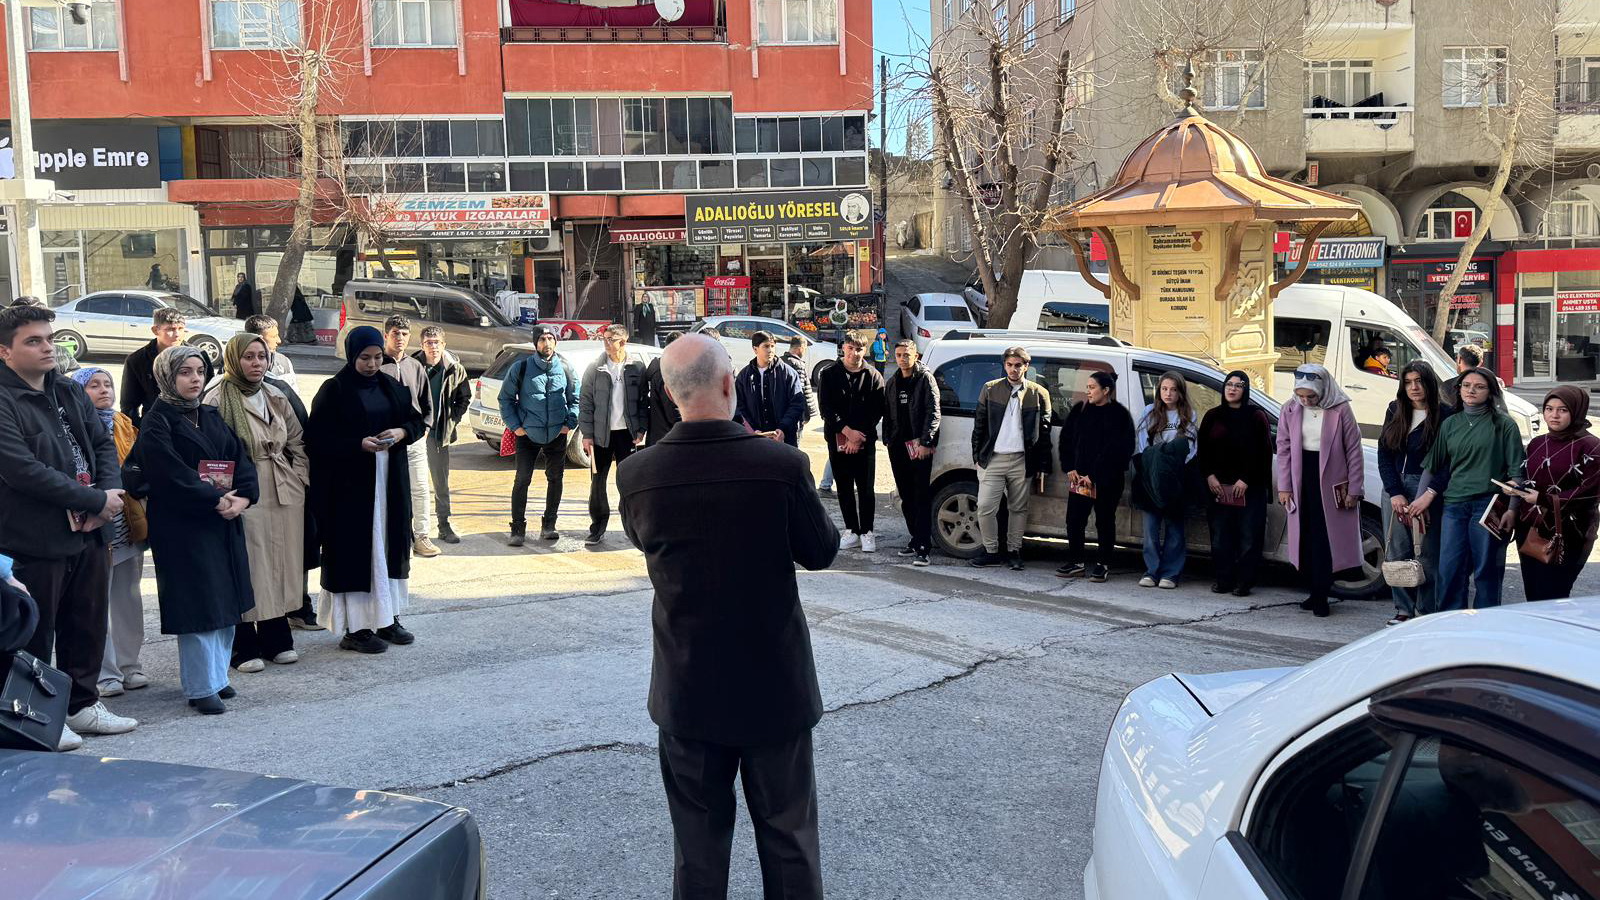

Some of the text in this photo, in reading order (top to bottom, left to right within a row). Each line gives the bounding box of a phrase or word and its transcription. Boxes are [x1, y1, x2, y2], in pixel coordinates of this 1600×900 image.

[92, 147, 150, 168] Emre
[404, 199, 486, 210] ZEMZEM
[415, 211, 457, 221] TAVUK
[695, 200, 839, 222] ADALIOĞLU YÖRESEL
[618, 231, 676, 242] ADALIOĞLU
[1444, 262, 1478, 271] STNG
